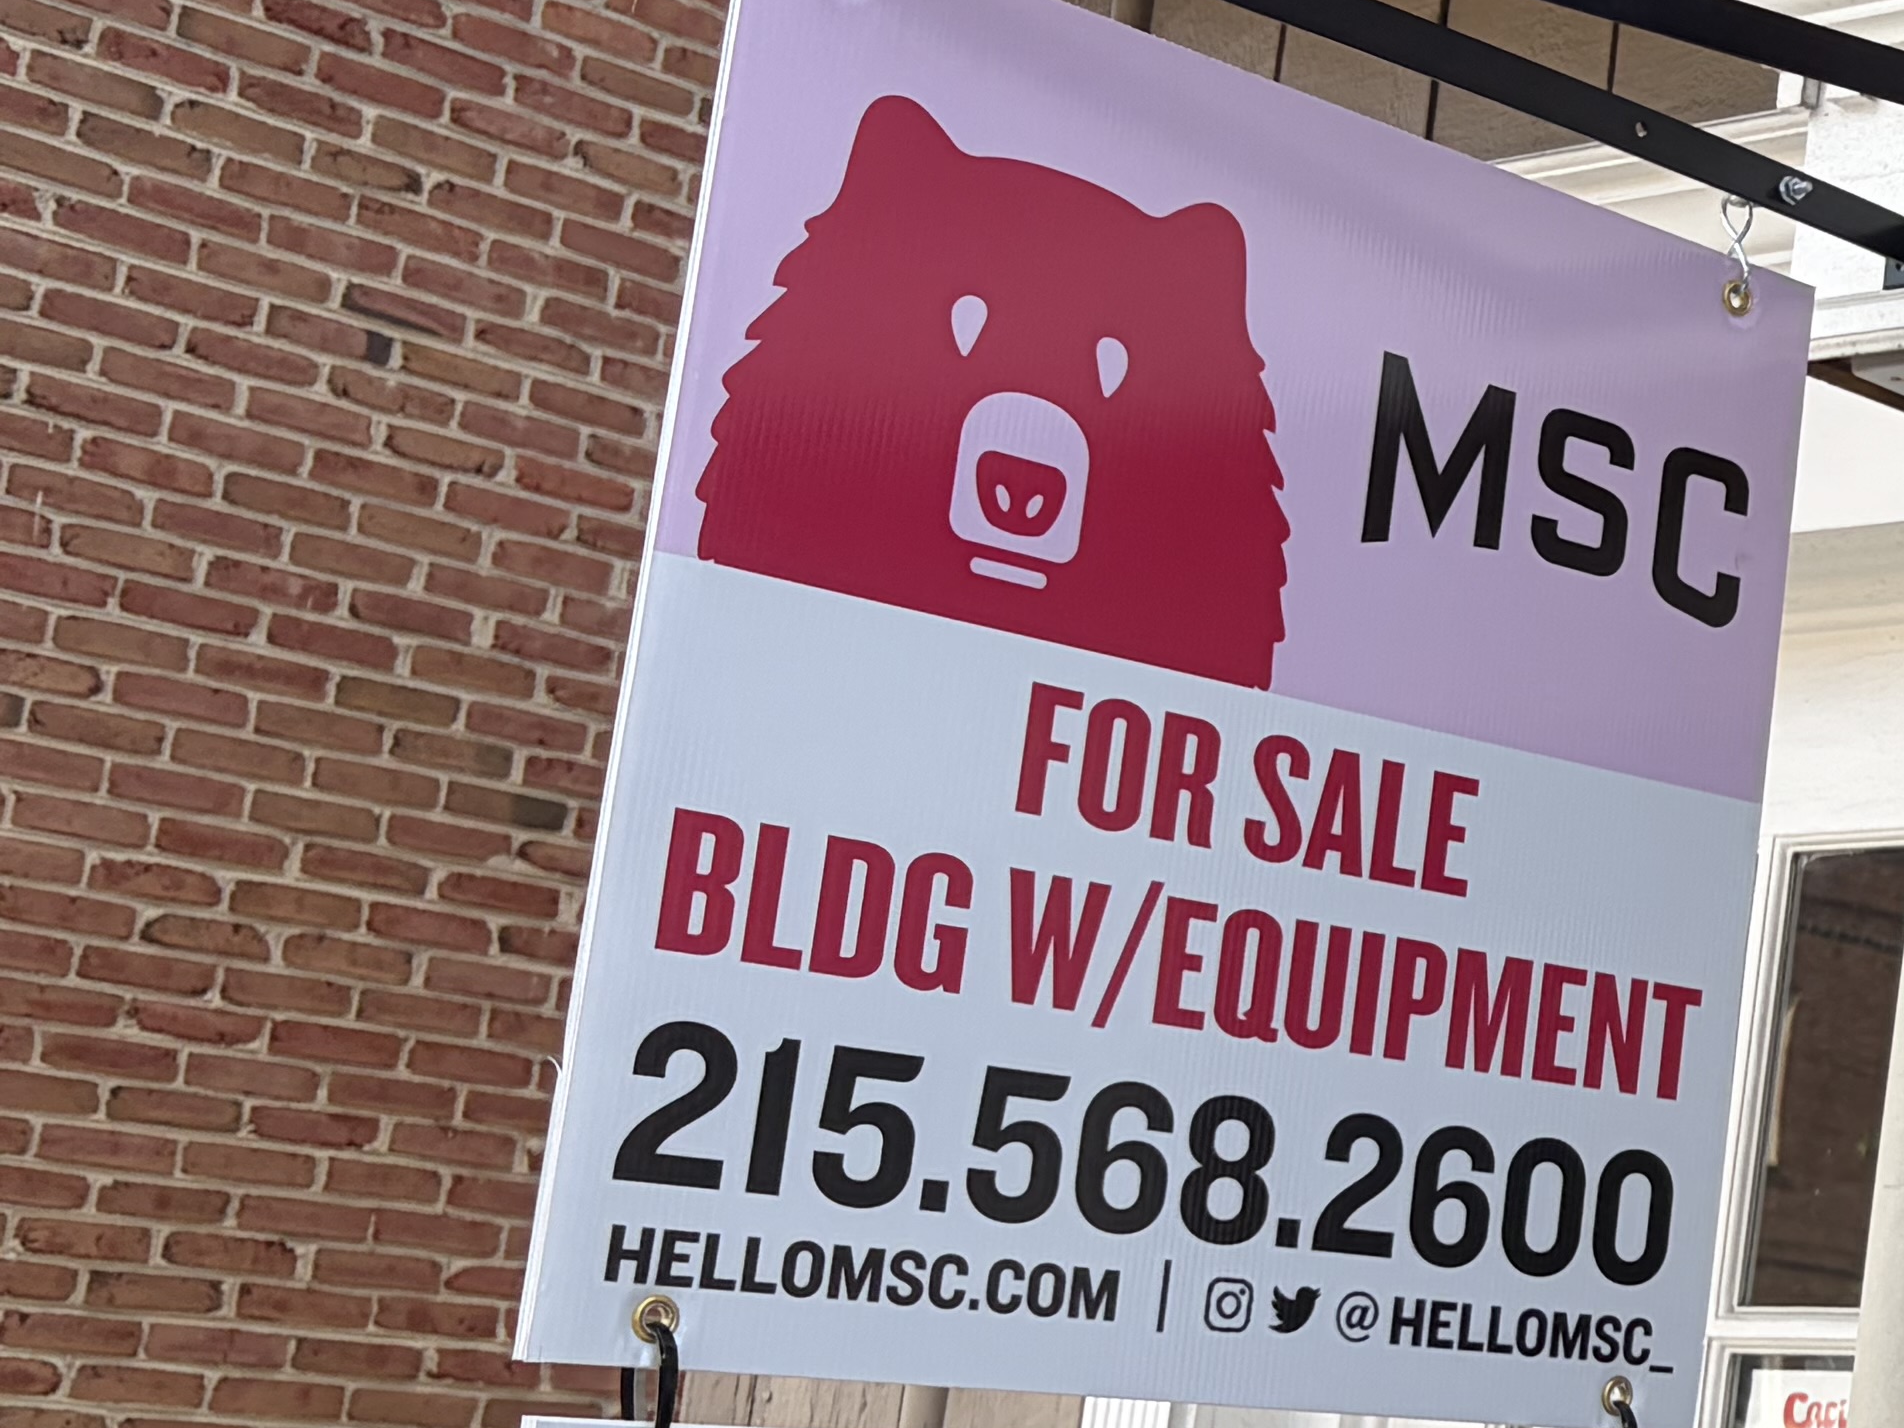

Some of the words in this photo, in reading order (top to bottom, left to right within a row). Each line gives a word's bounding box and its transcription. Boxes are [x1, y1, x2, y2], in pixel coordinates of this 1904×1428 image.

[1361, 351, 1749, 628] MSC
[1018, 684, 1219, 847] FOR
[1246, 737, 1478, 895] SALE
[657, 810, 972, 992] BLDG
[1012, 870, 1701, 1098] W/EQUIPMENT
[604, 1225, 1120, 1321] HELLOMSC.COM
[613, 1021, 1673, 1286] 215.568.2600
